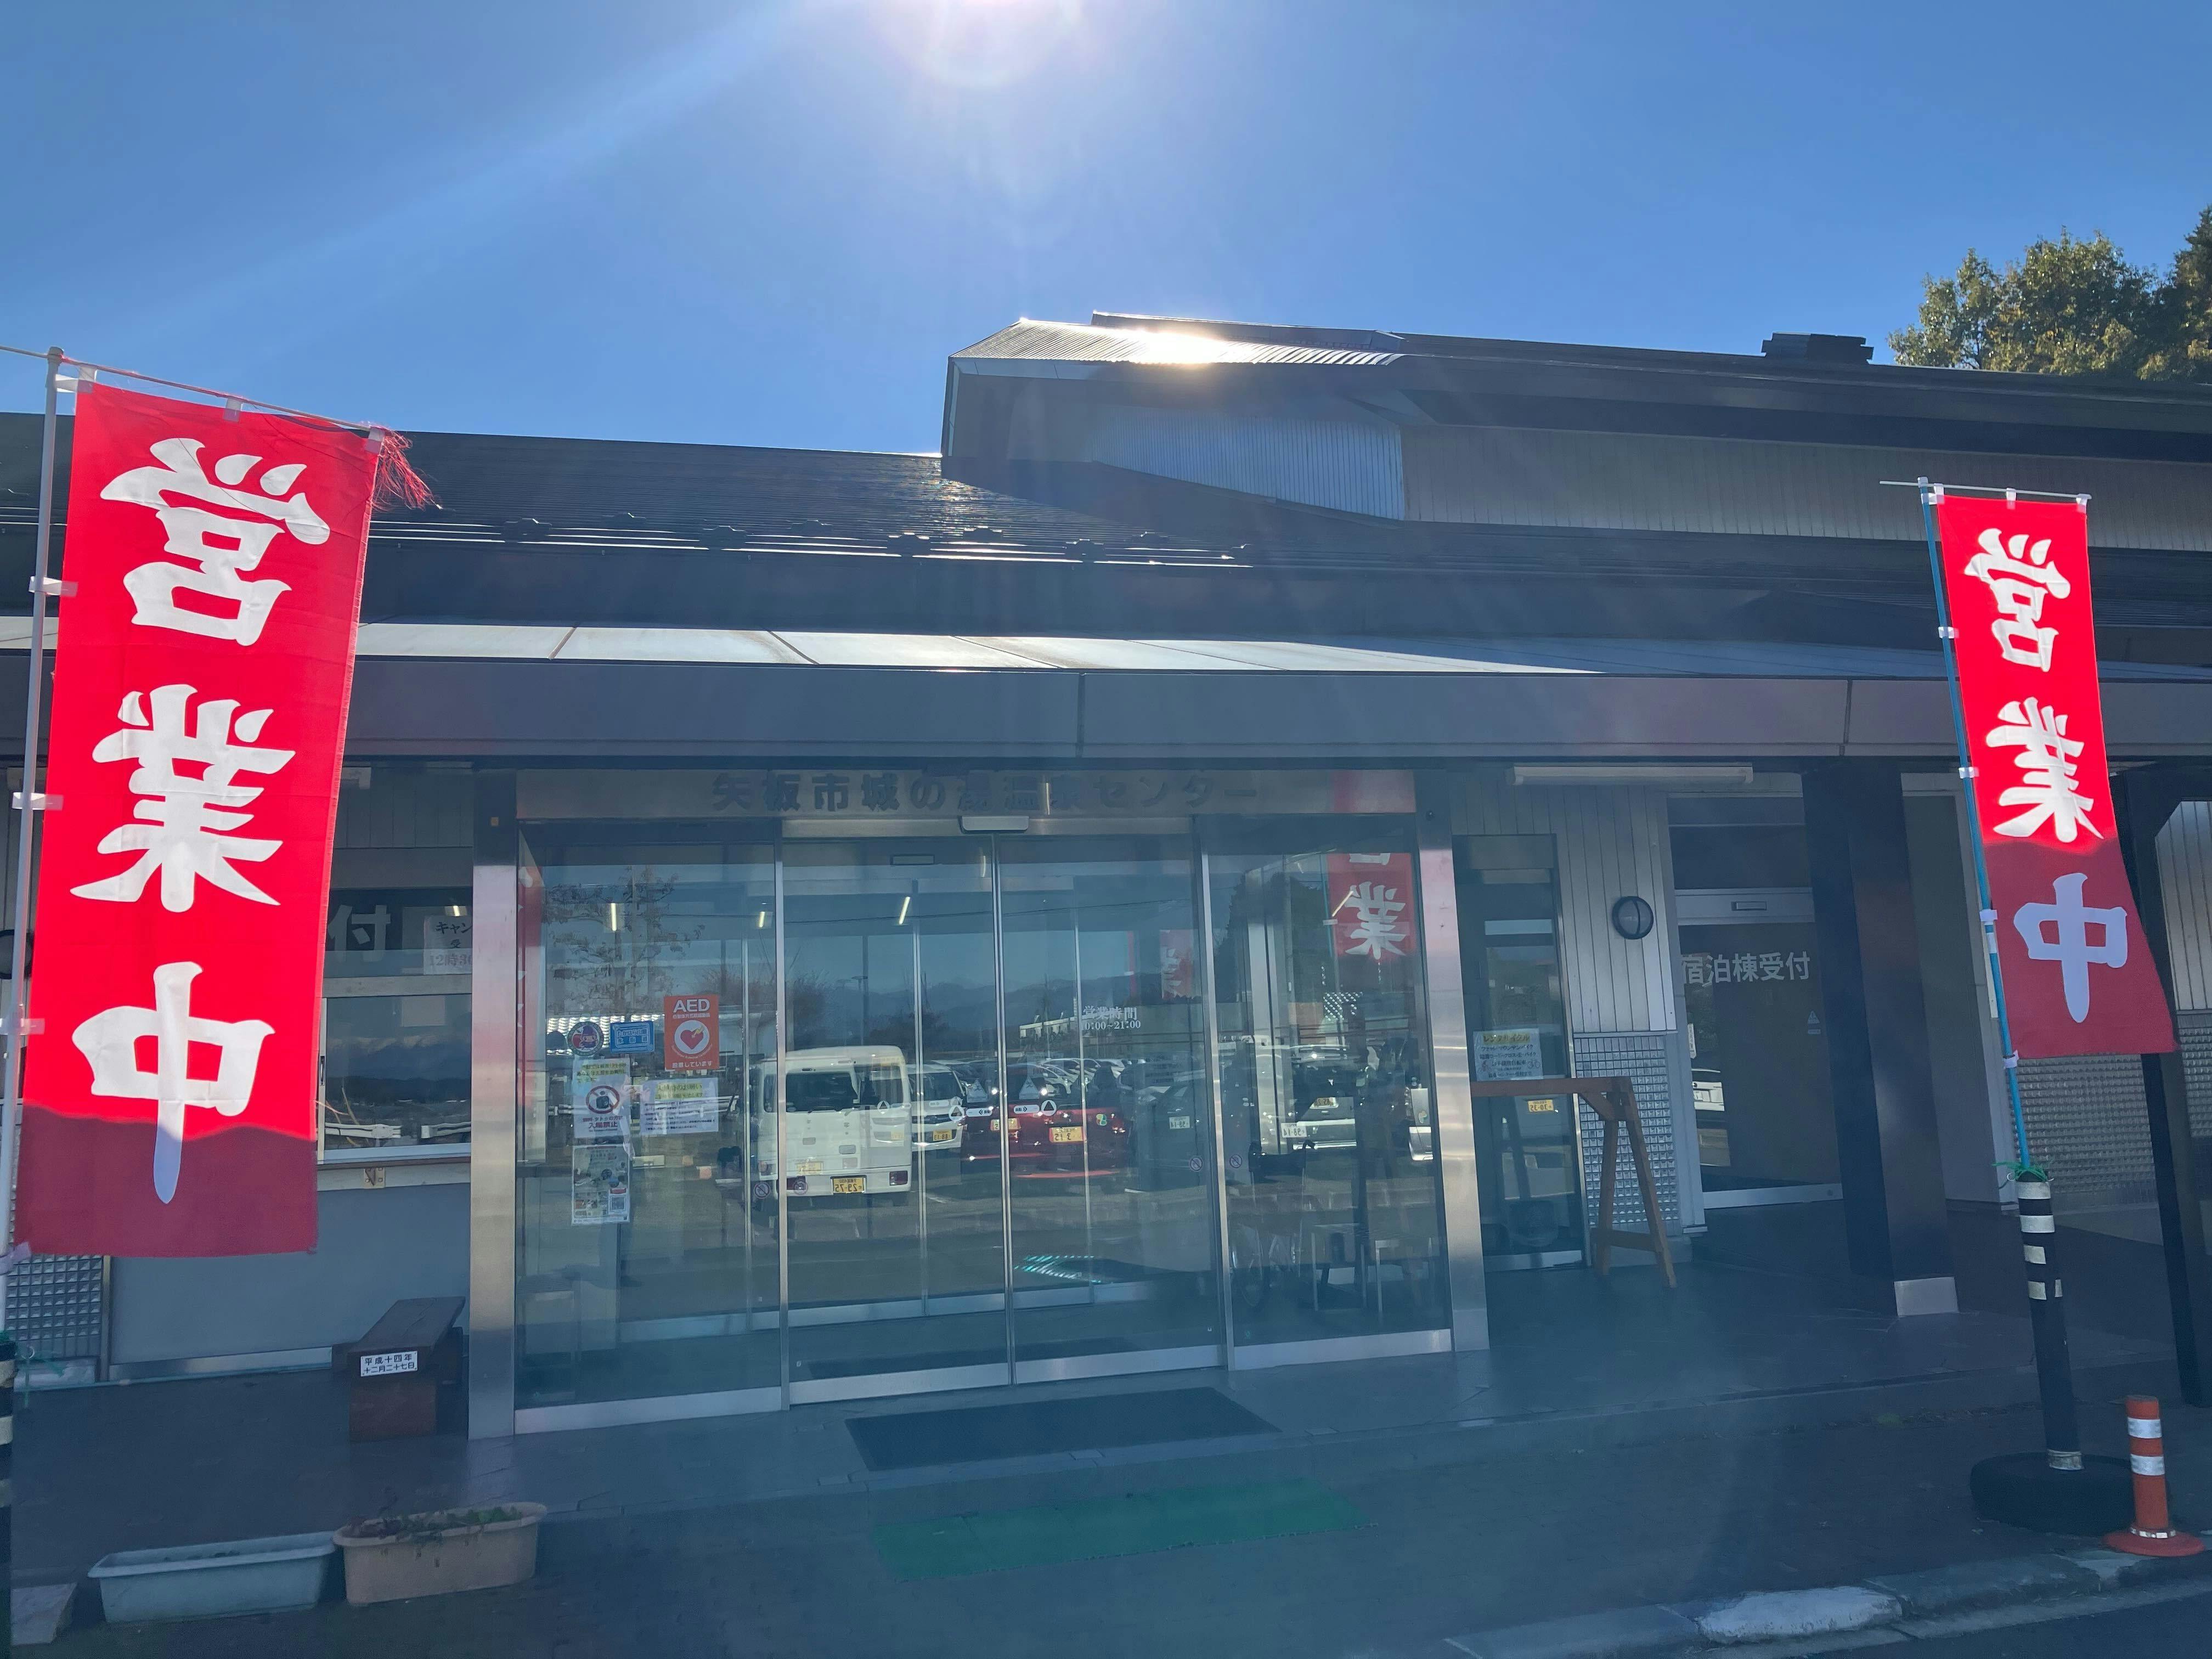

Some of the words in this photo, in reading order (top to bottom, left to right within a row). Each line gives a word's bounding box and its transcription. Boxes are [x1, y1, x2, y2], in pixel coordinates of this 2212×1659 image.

[1964, 528, 2128, 1023] 営業中
[70, 438, 330, 1204] 営業中
[1681, 951, 1811, 988] 宿泊棟受付
[673, 998, 710, 1013] AED
[364, 1362, 415, 1374] 十二月二十七日
[365, 1353, 413, 1365] 平成十四年
